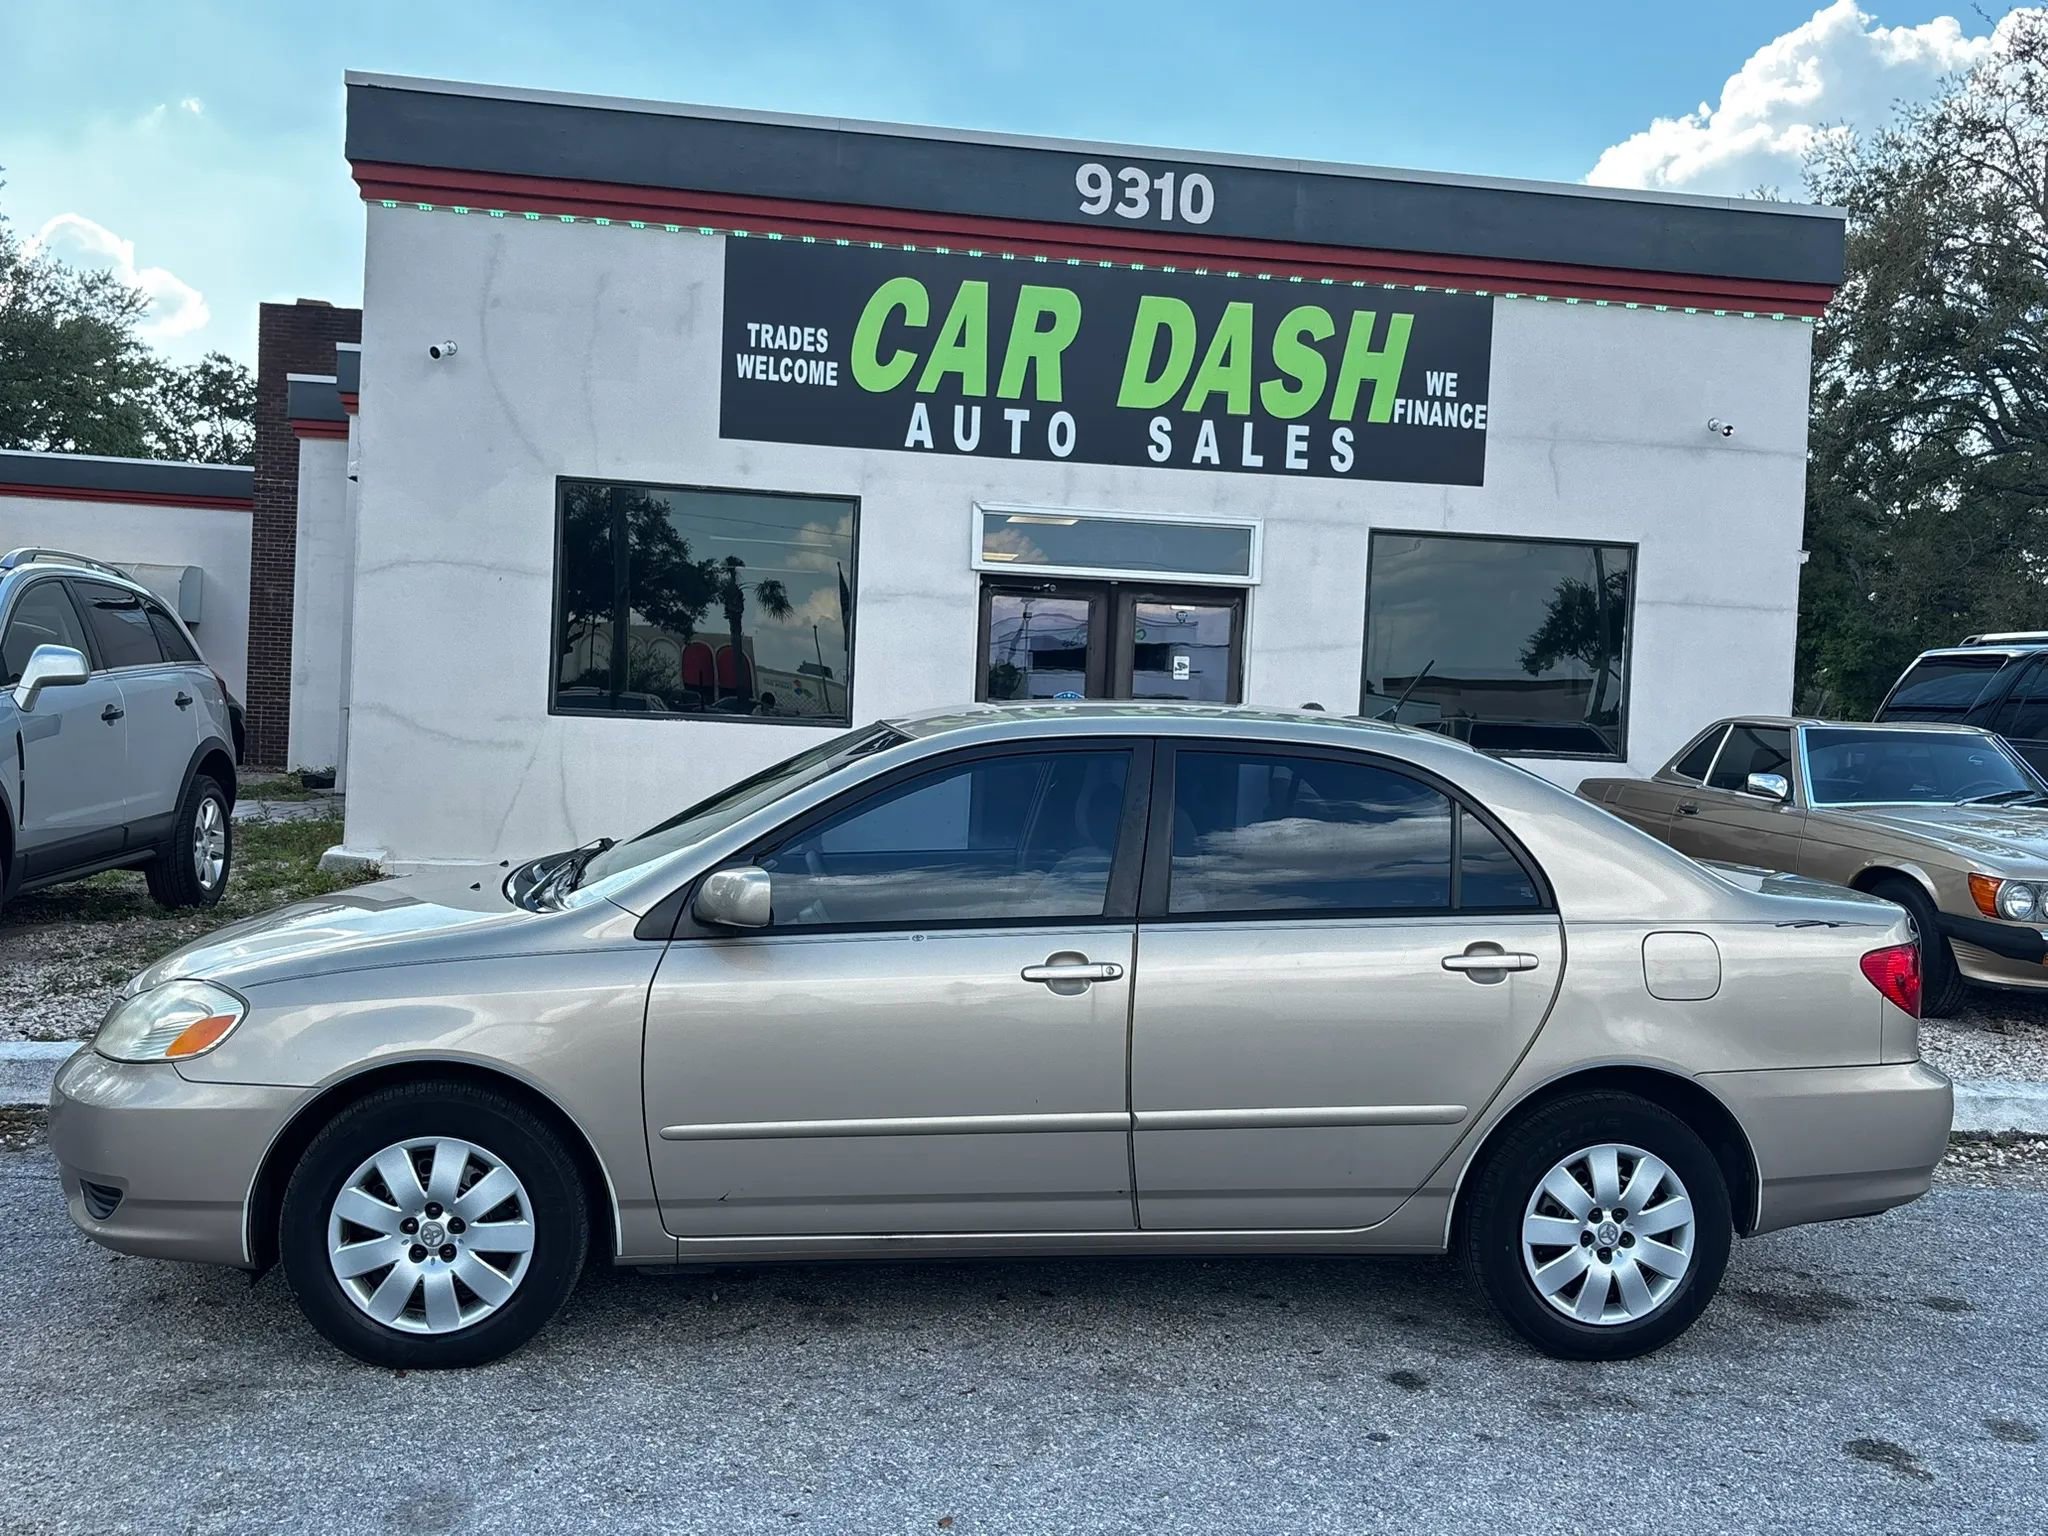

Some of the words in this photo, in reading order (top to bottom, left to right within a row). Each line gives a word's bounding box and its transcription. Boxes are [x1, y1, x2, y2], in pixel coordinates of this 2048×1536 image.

[1075, 163, 1215, 224] 9310
[746, 322, 829, 353] TRADES
[850, 277, 1082, 403] CAR
[1117, 295, 1414, 423] DASH
[736, 353, 839, 387] WELCOME
[1426, 371, 1457, 397] WE
[1393, 398, 1487, 430] FINANCE
[904, 402, 1077, 458] AUTO
[1147, 416, 1355, 473] SALES
